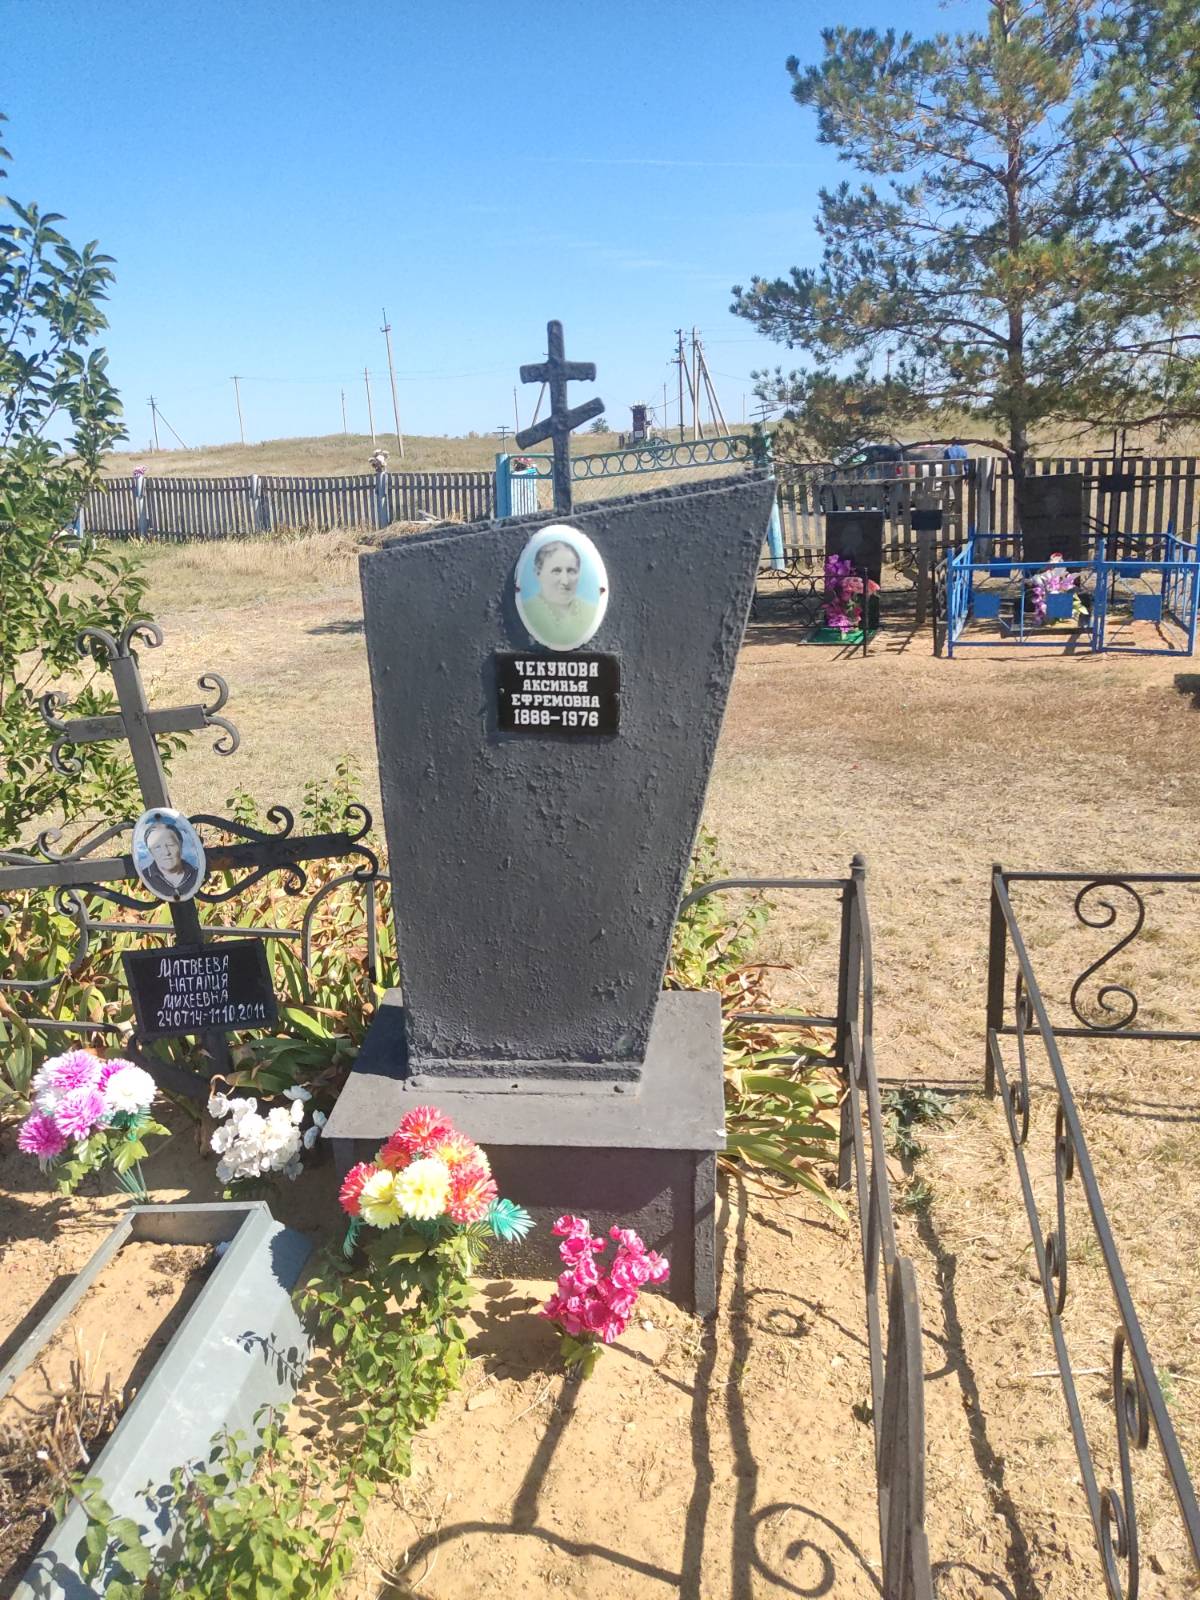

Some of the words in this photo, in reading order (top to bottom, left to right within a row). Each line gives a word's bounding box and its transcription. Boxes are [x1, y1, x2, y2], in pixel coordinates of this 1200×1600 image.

[514, 661, 599, 677] ЧЕКУНОВА
[522, 679, 588, 692] АКСИНЬЯ
[511, 694, 600, 708] ЕФРЕМОВНА
[514, 709, 599, 727] 1888-1976
[157, 955, 229, 978] МАТВЕЕВА
[169, 973, 228, 993] НАТАЛИЯ
[162, 990, 229, 1010] МИХЕЕВНА
